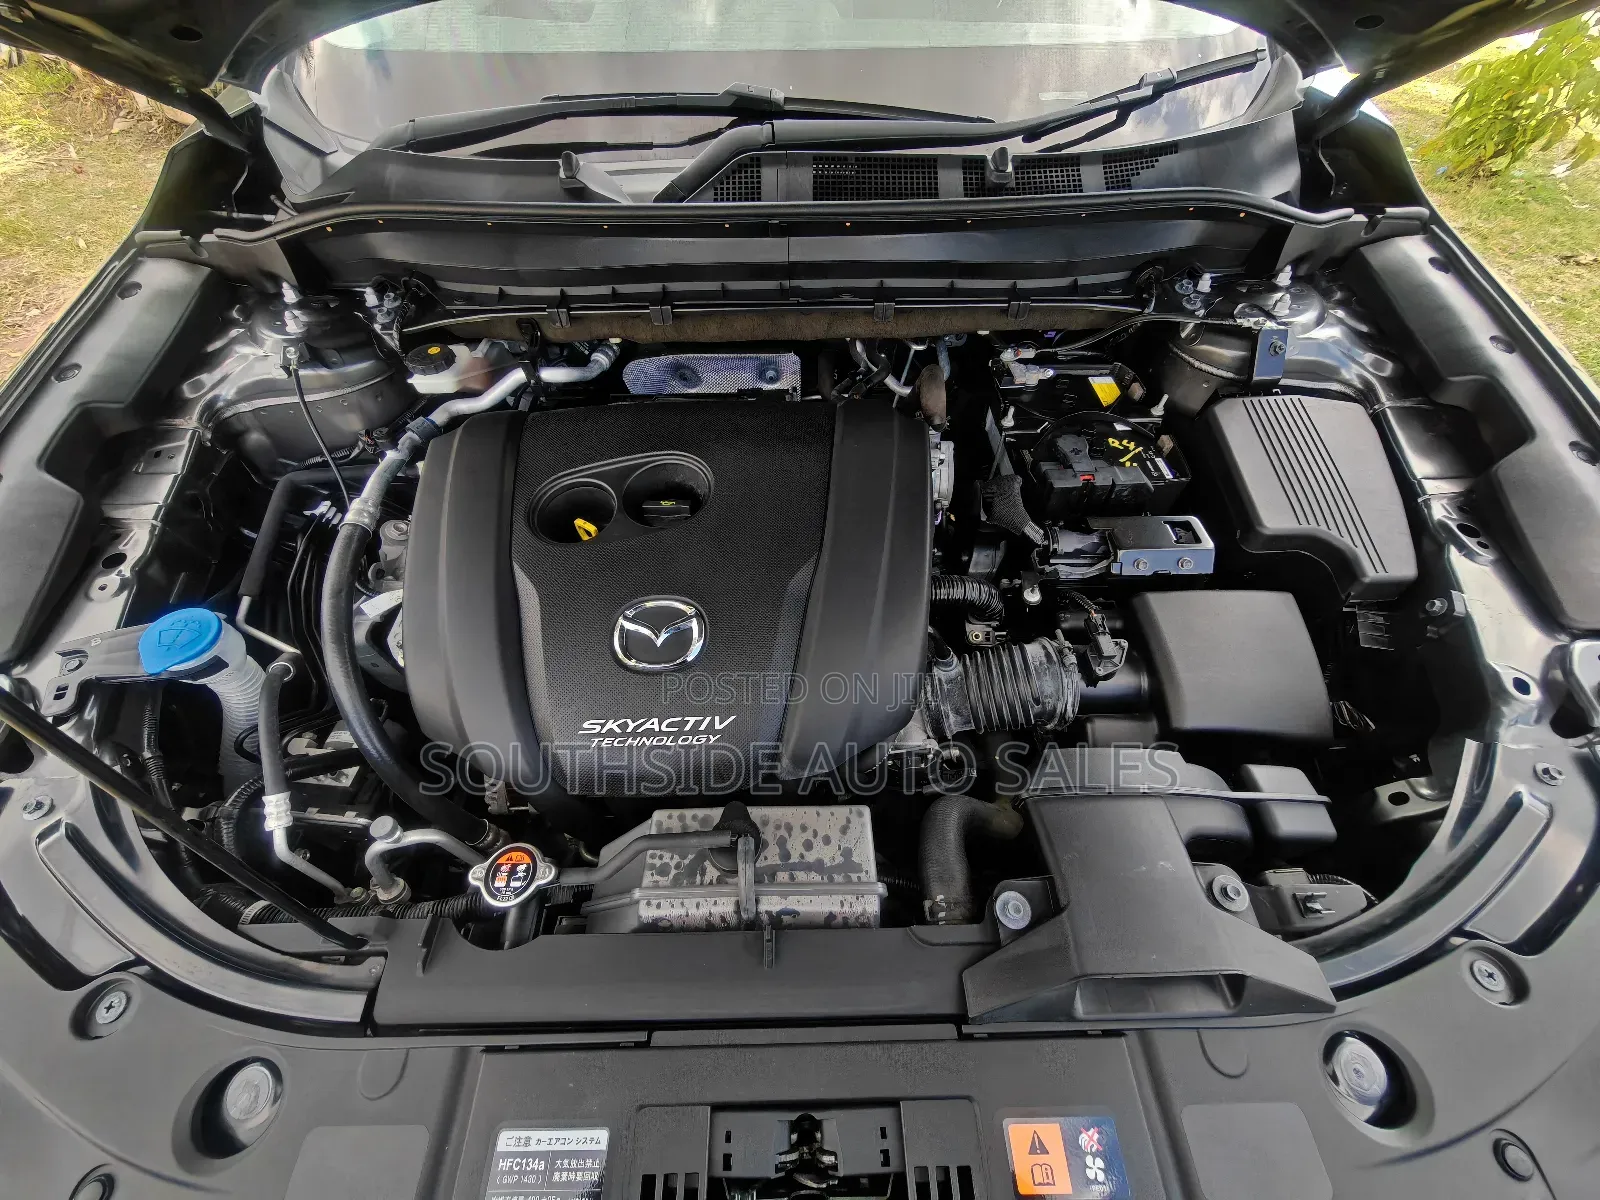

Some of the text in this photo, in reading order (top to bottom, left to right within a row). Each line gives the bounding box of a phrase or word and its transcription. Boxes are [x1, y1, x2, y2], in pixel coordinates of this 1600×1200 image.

[578, 715, 737, 734] SKYACTIV
[590, 734, 722, 748] TECHNOLOGY
[505, 1135, 533, 1148] ご注意
[497, 1157, 545, 1171] HFC134a
